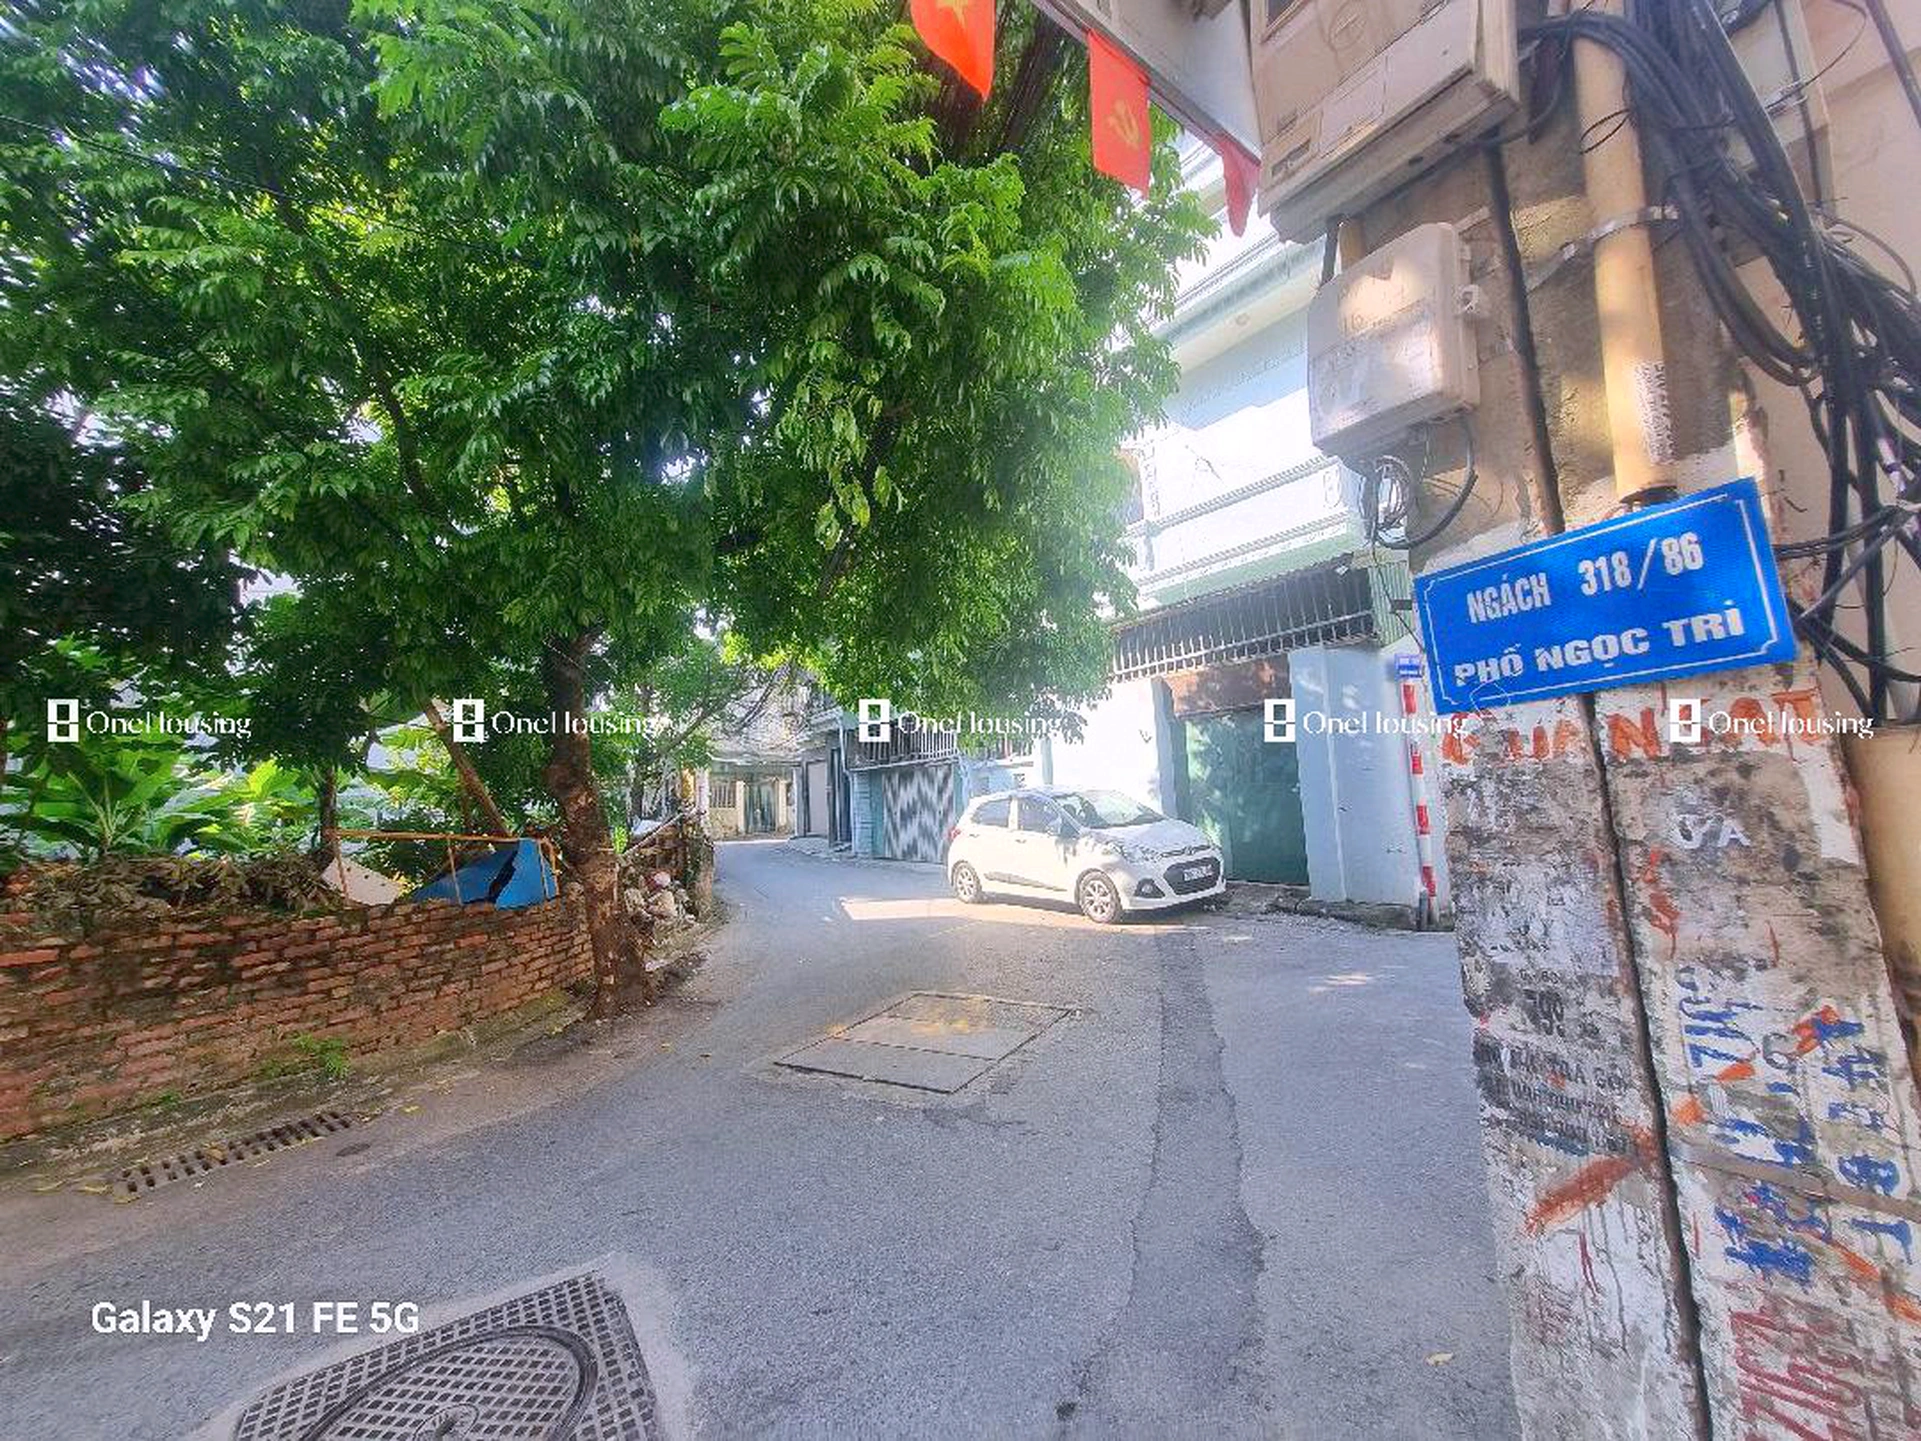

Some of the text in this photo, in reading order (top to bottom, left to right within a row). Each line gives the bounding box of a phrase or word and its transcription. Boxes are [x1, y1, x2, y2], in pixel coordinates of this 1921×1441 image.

[1467, 573, 1551, 624] NGÁCH
[1454, 643, 1524, 687] PHỐ
[1534, 627, 1650, 672] NGỌC
